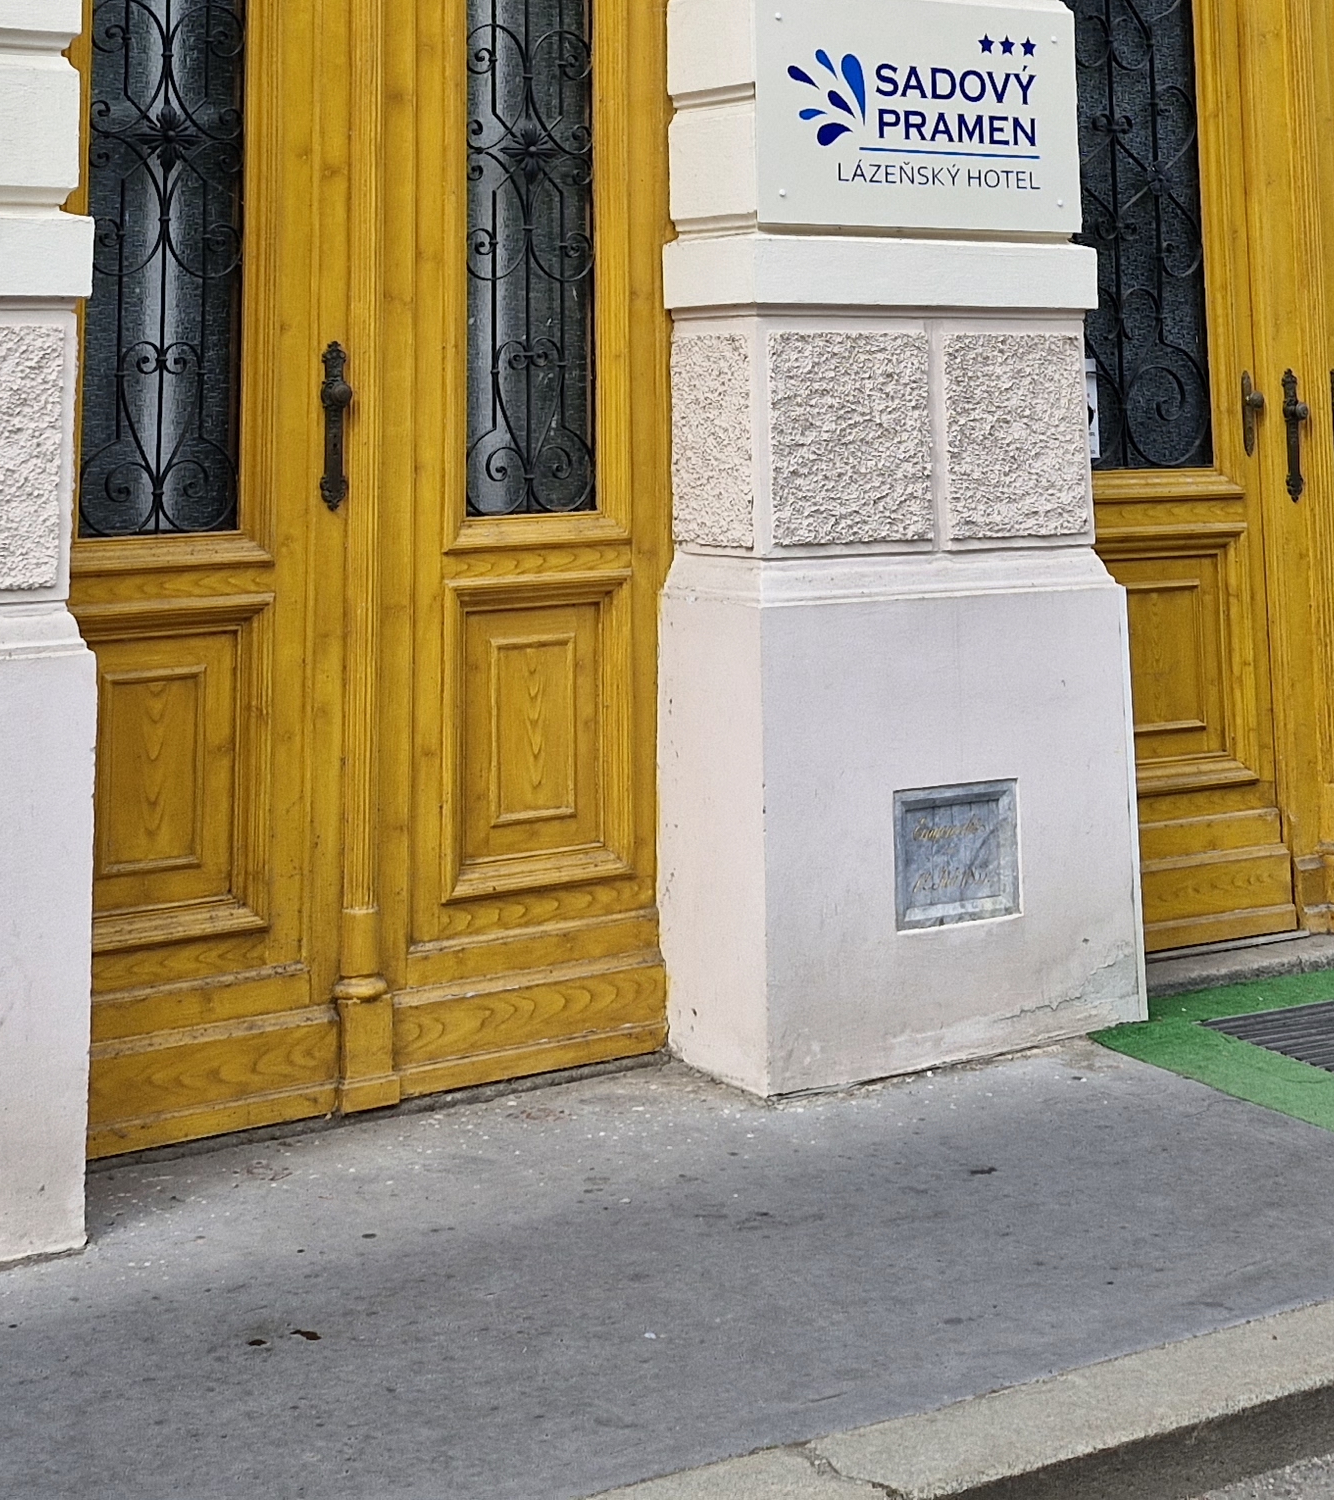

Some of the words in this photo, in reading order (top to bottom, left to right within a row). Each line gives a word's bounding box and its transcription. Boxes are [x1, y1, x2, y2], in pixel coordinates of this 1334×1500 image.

[875, 63, 1036, 105] SADOVÝ
[877, 109, 1037, 146] PRAMEN
[837, 159, 960, 186] LÁZEŇSKÝ
[967, 169, 1041, 190] HOTEL
